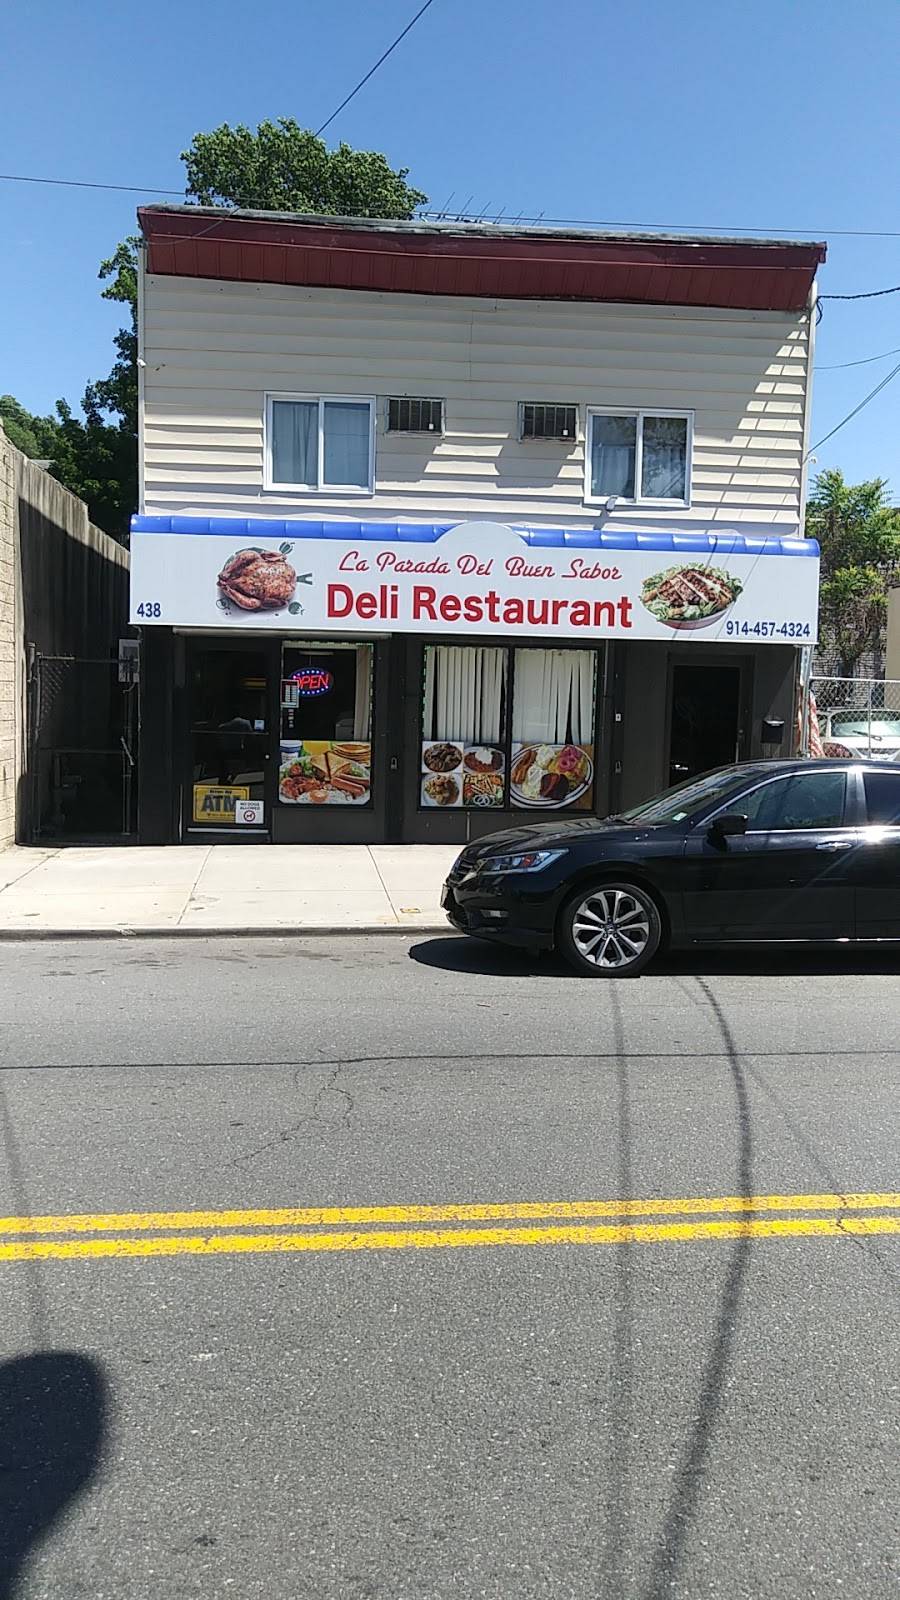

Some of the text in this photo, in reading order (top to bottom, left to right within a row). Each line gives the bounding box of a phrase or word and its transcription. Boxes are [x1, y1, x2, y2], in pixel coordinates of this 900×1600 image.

[339, 551, 622, 580] La Parada Del Buen Sabor
[136, 602, 161, 618] 438
[327, 583, 632, 628] Deli Restaurant
[726, 620, 811, 637] 914-457-4324
